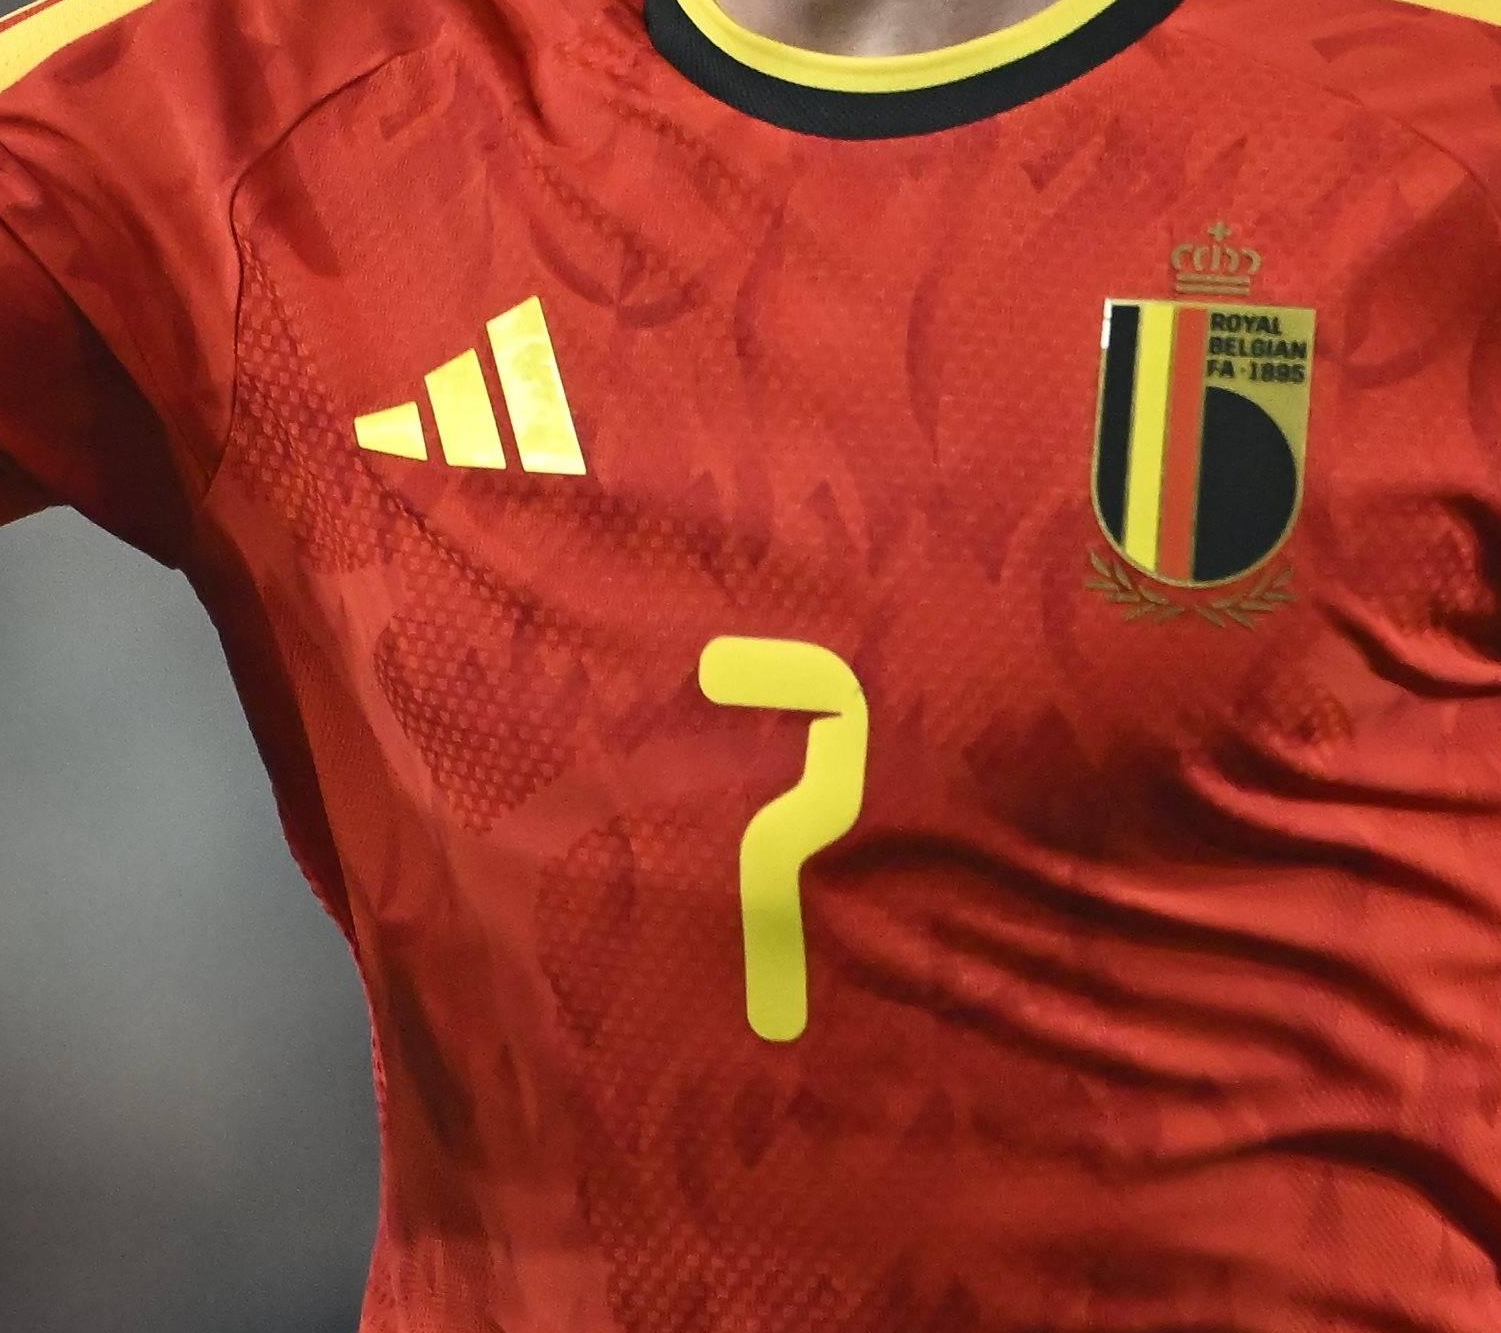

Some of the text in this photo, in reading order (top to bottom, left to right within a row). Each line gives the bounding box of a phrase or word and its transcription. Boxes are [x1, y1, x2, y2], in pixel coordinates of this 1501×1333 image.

[1210, 313, 1282, 336] ROYAL
[1208, 337, 1307, 359] BELGIAN
[698, 634, 869, 1043] 7
